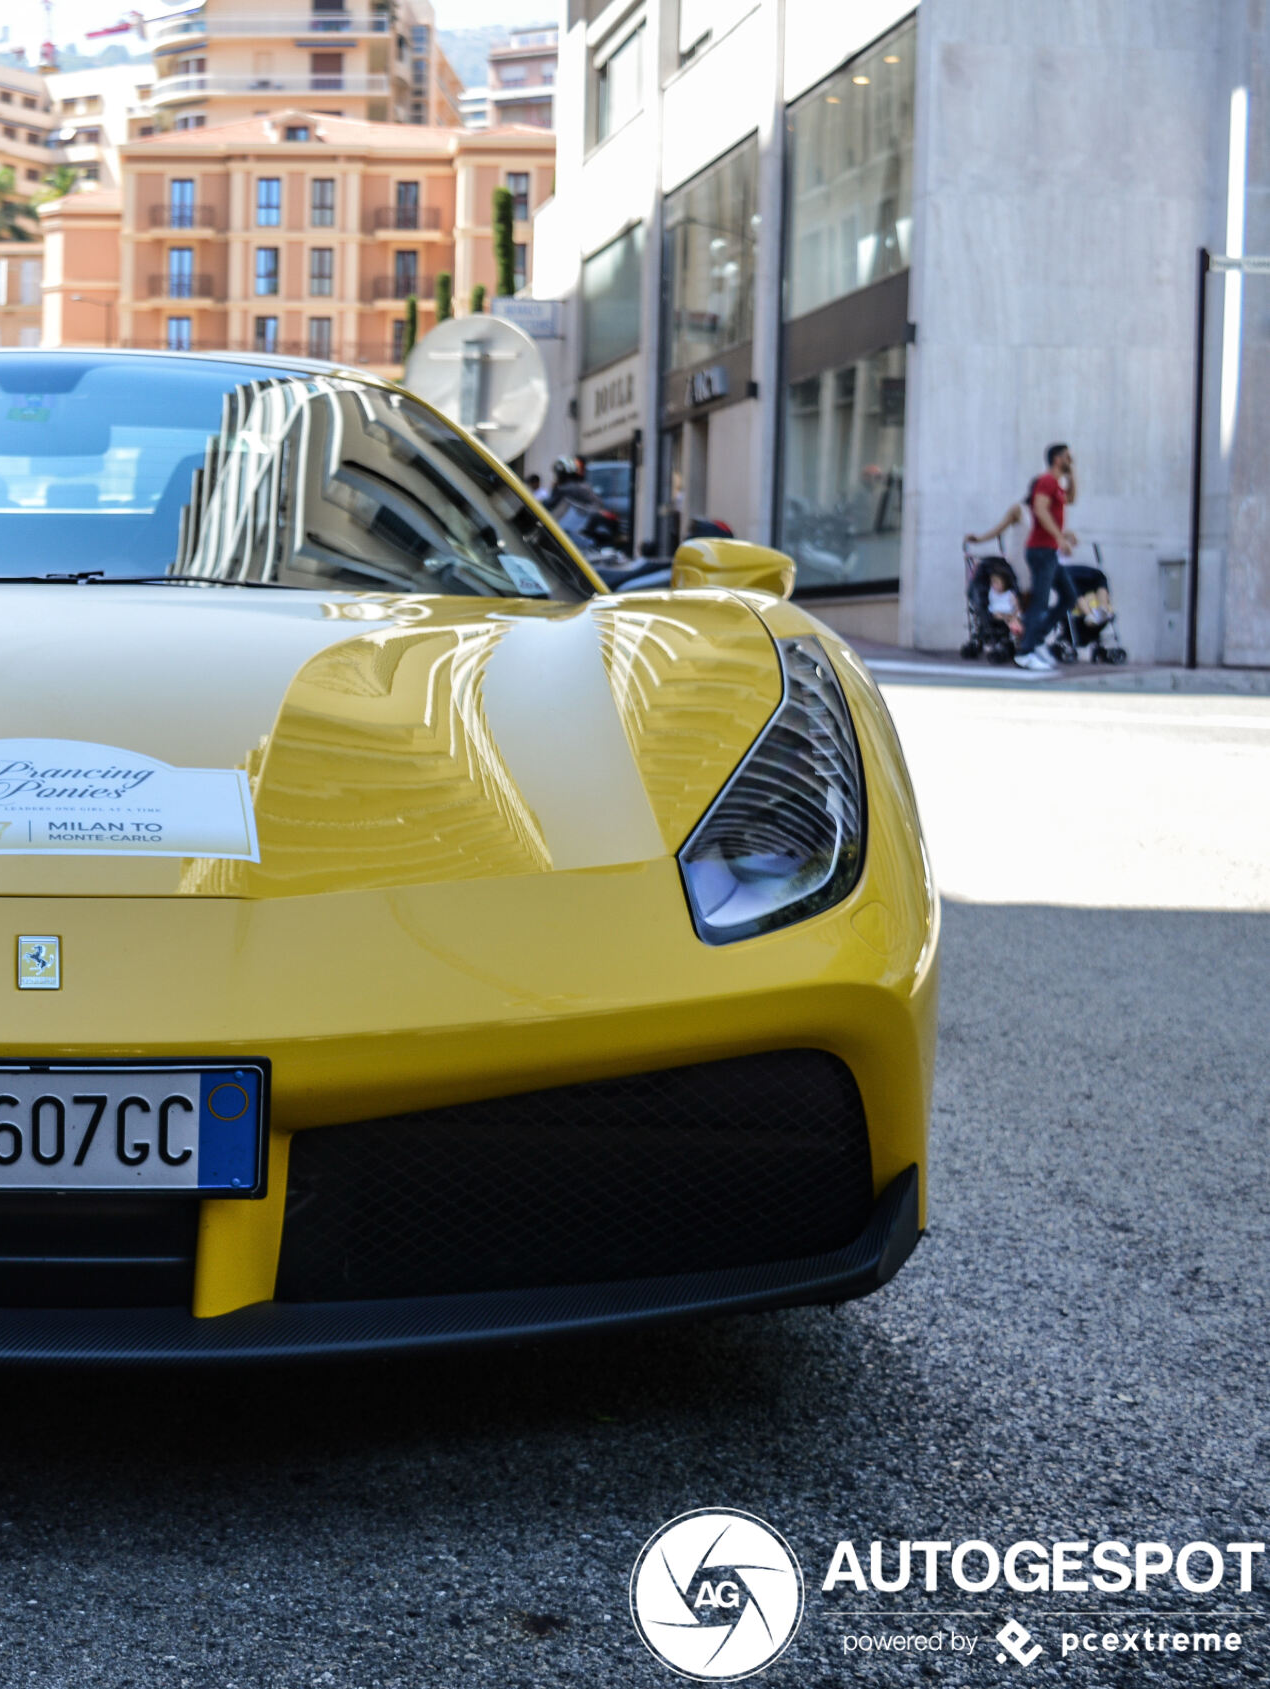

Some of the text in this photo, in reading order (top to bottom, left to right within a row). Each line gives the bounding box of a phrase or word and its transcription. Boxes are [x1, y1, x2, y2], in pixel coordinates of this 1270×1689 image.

[49, 821, 163, 833] MILAN TO
[49, 833, 162, 842] MONTE-CARLO
